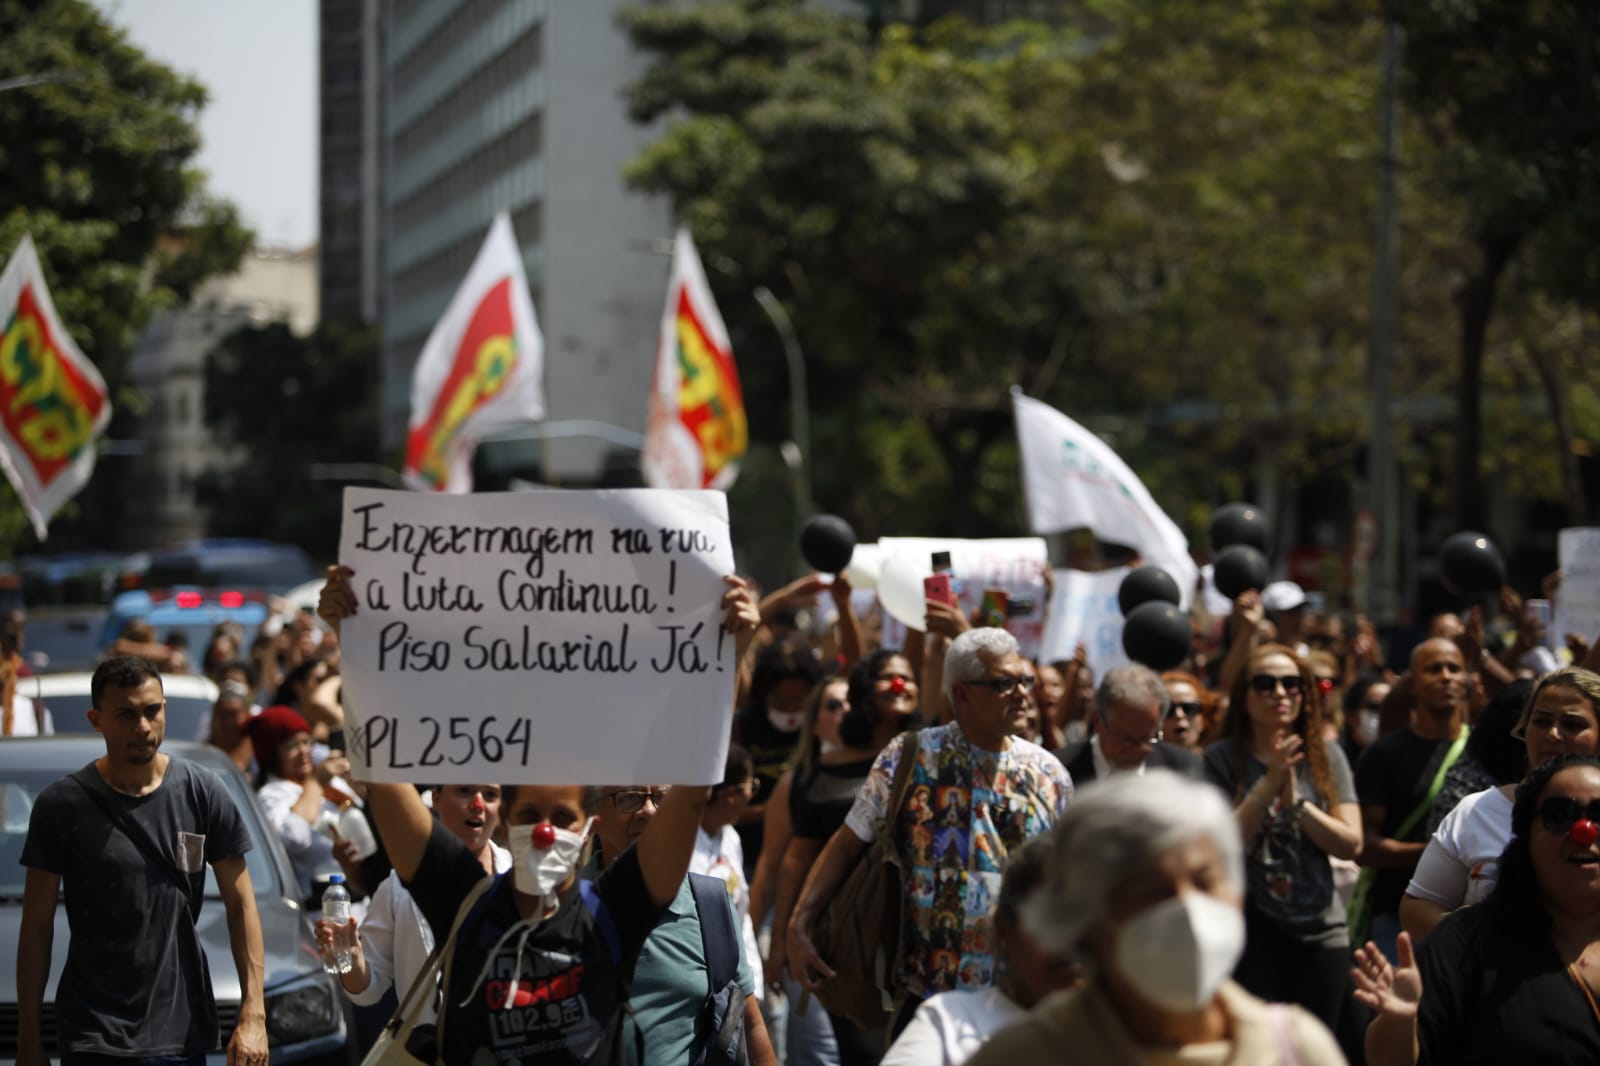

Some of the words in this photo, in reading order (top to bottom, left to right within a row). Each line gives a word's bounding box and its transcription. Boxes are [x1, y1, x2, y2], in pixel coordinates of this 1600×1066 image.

[352, 501, 593, 579] Enfermagem
[609, 526, 653, 554] na
[657, 526, 716, 554] rua
[366, 578, 391, 612] a
[402, 571, 484, 612] luta
[377, 620, 451, 673] Piso
[463, 622, 638, 674] Salarial
[651, 620, 727, 674] Já!
